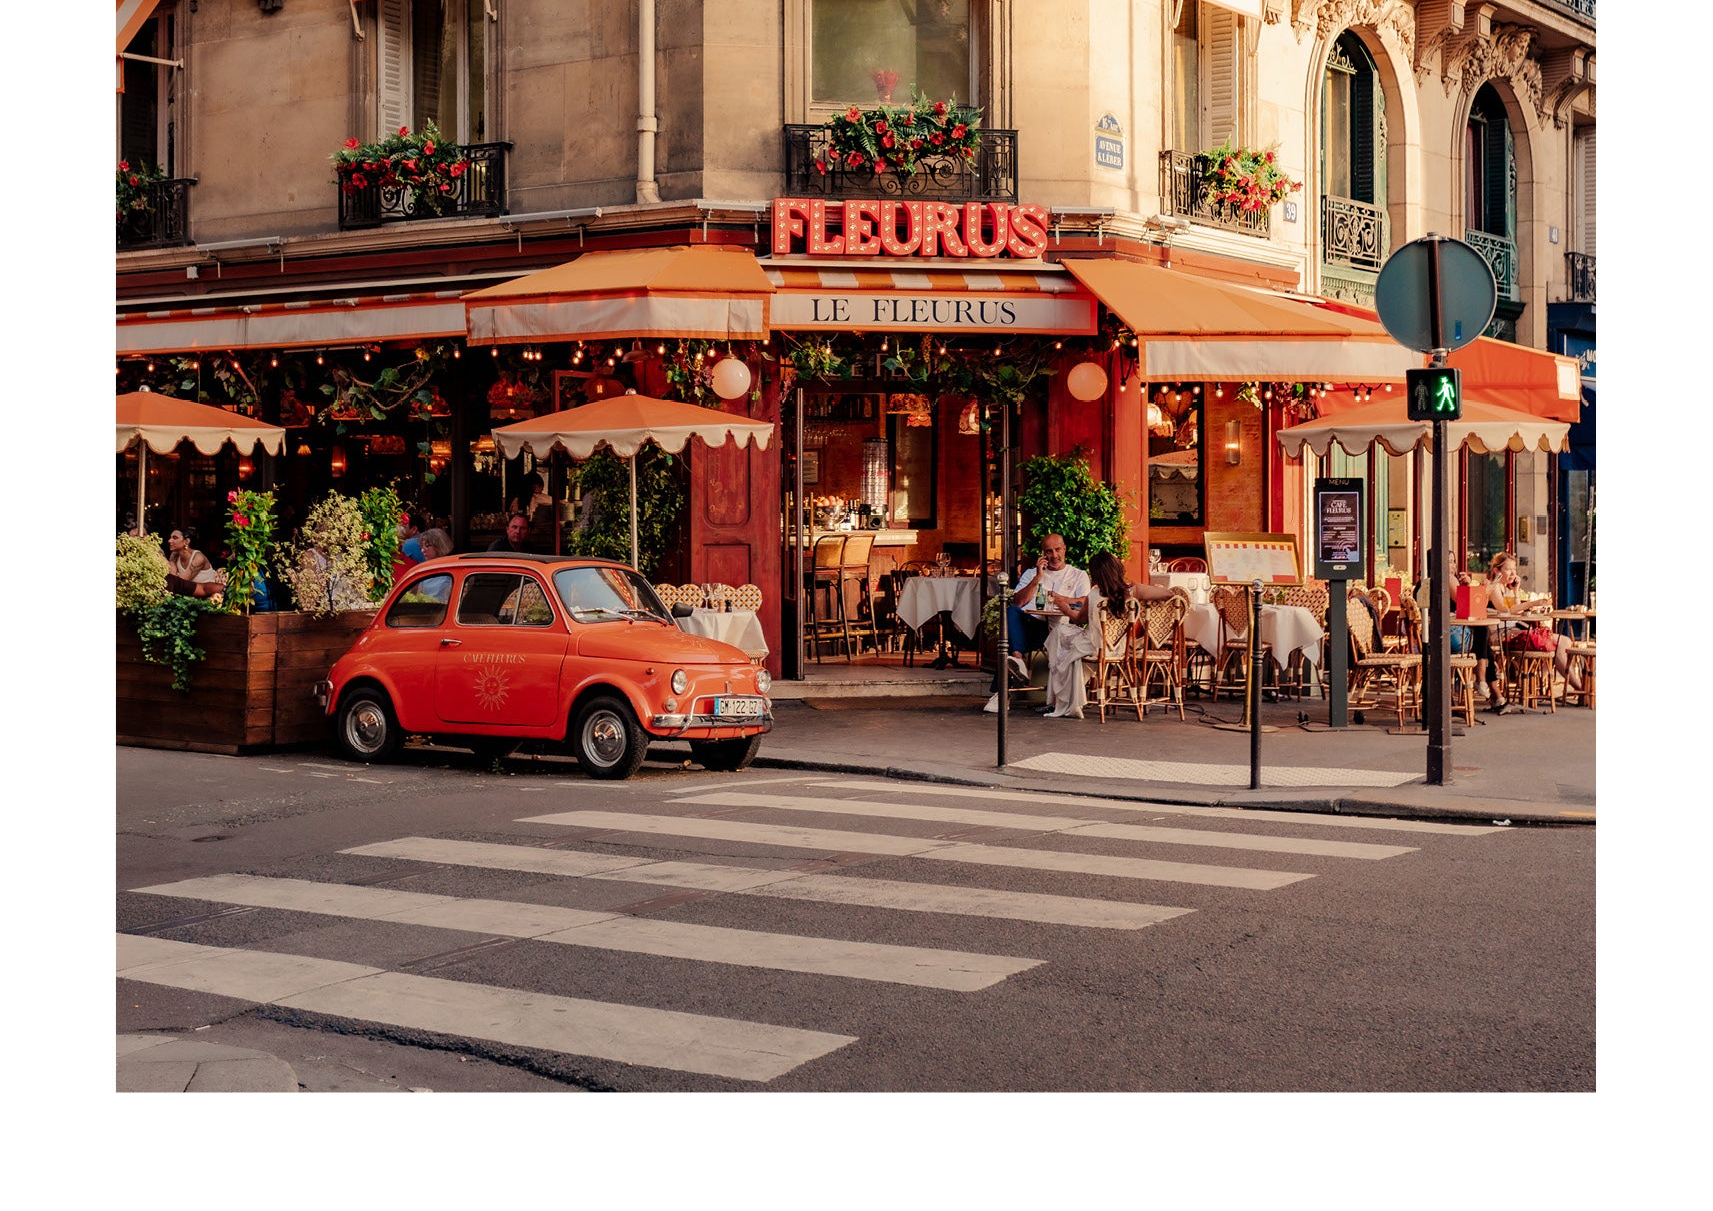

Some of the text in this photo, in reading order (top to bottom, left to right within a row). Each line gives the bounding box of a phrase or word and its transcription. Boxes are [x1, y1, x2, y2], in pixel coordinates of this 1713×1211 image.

[1286, 202, 1296, 220] 39
[772, 198, 1049, 258] FLEURUS
[811, 298, 1017, 326] LE FLEURUS
[1329, 478, 1350, 486] MENU
